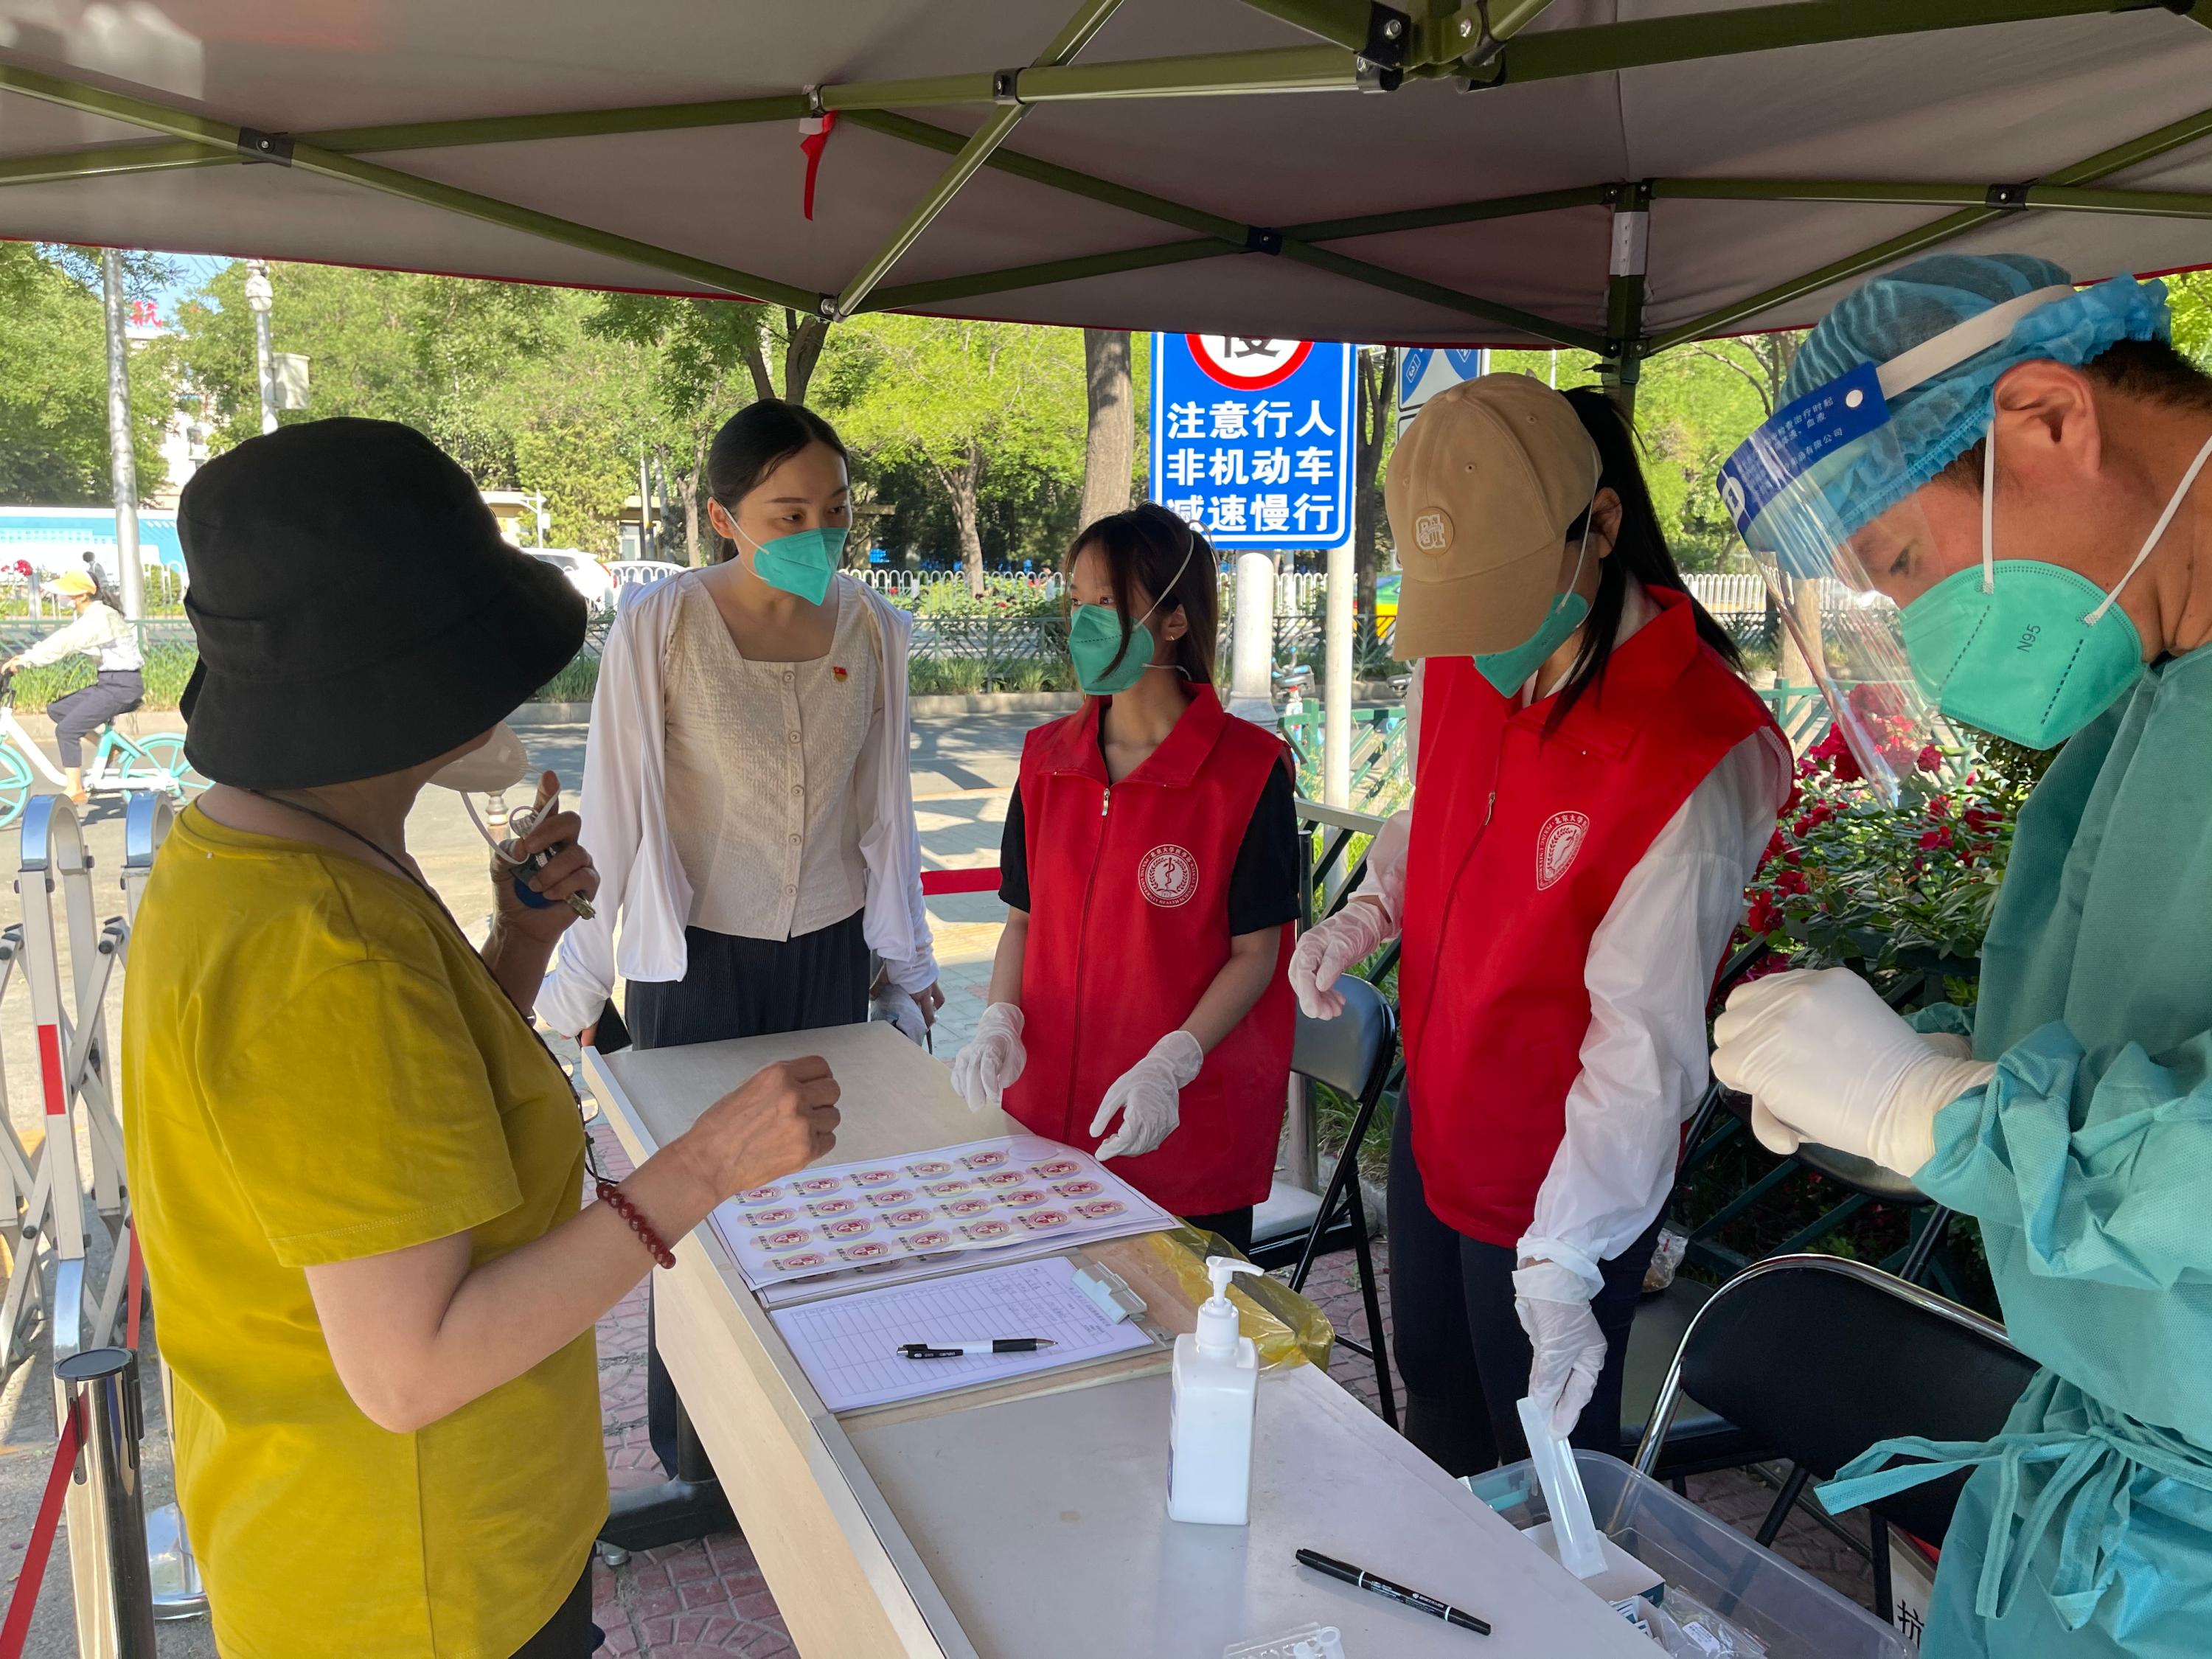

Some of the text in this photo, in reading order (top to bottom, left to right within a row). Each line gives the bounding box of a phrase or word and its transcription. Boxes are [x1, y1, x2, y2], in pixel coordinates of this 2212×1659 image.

[1166, 400, 1336, 439] 注意行人
[1166, 446, 1334, 486] 非机动车
[1166, 493, 1335, 532] 减速慢行
[2017, 624, 2041, 653] N95
[1896, 1599, 1925, 1650] 抗
